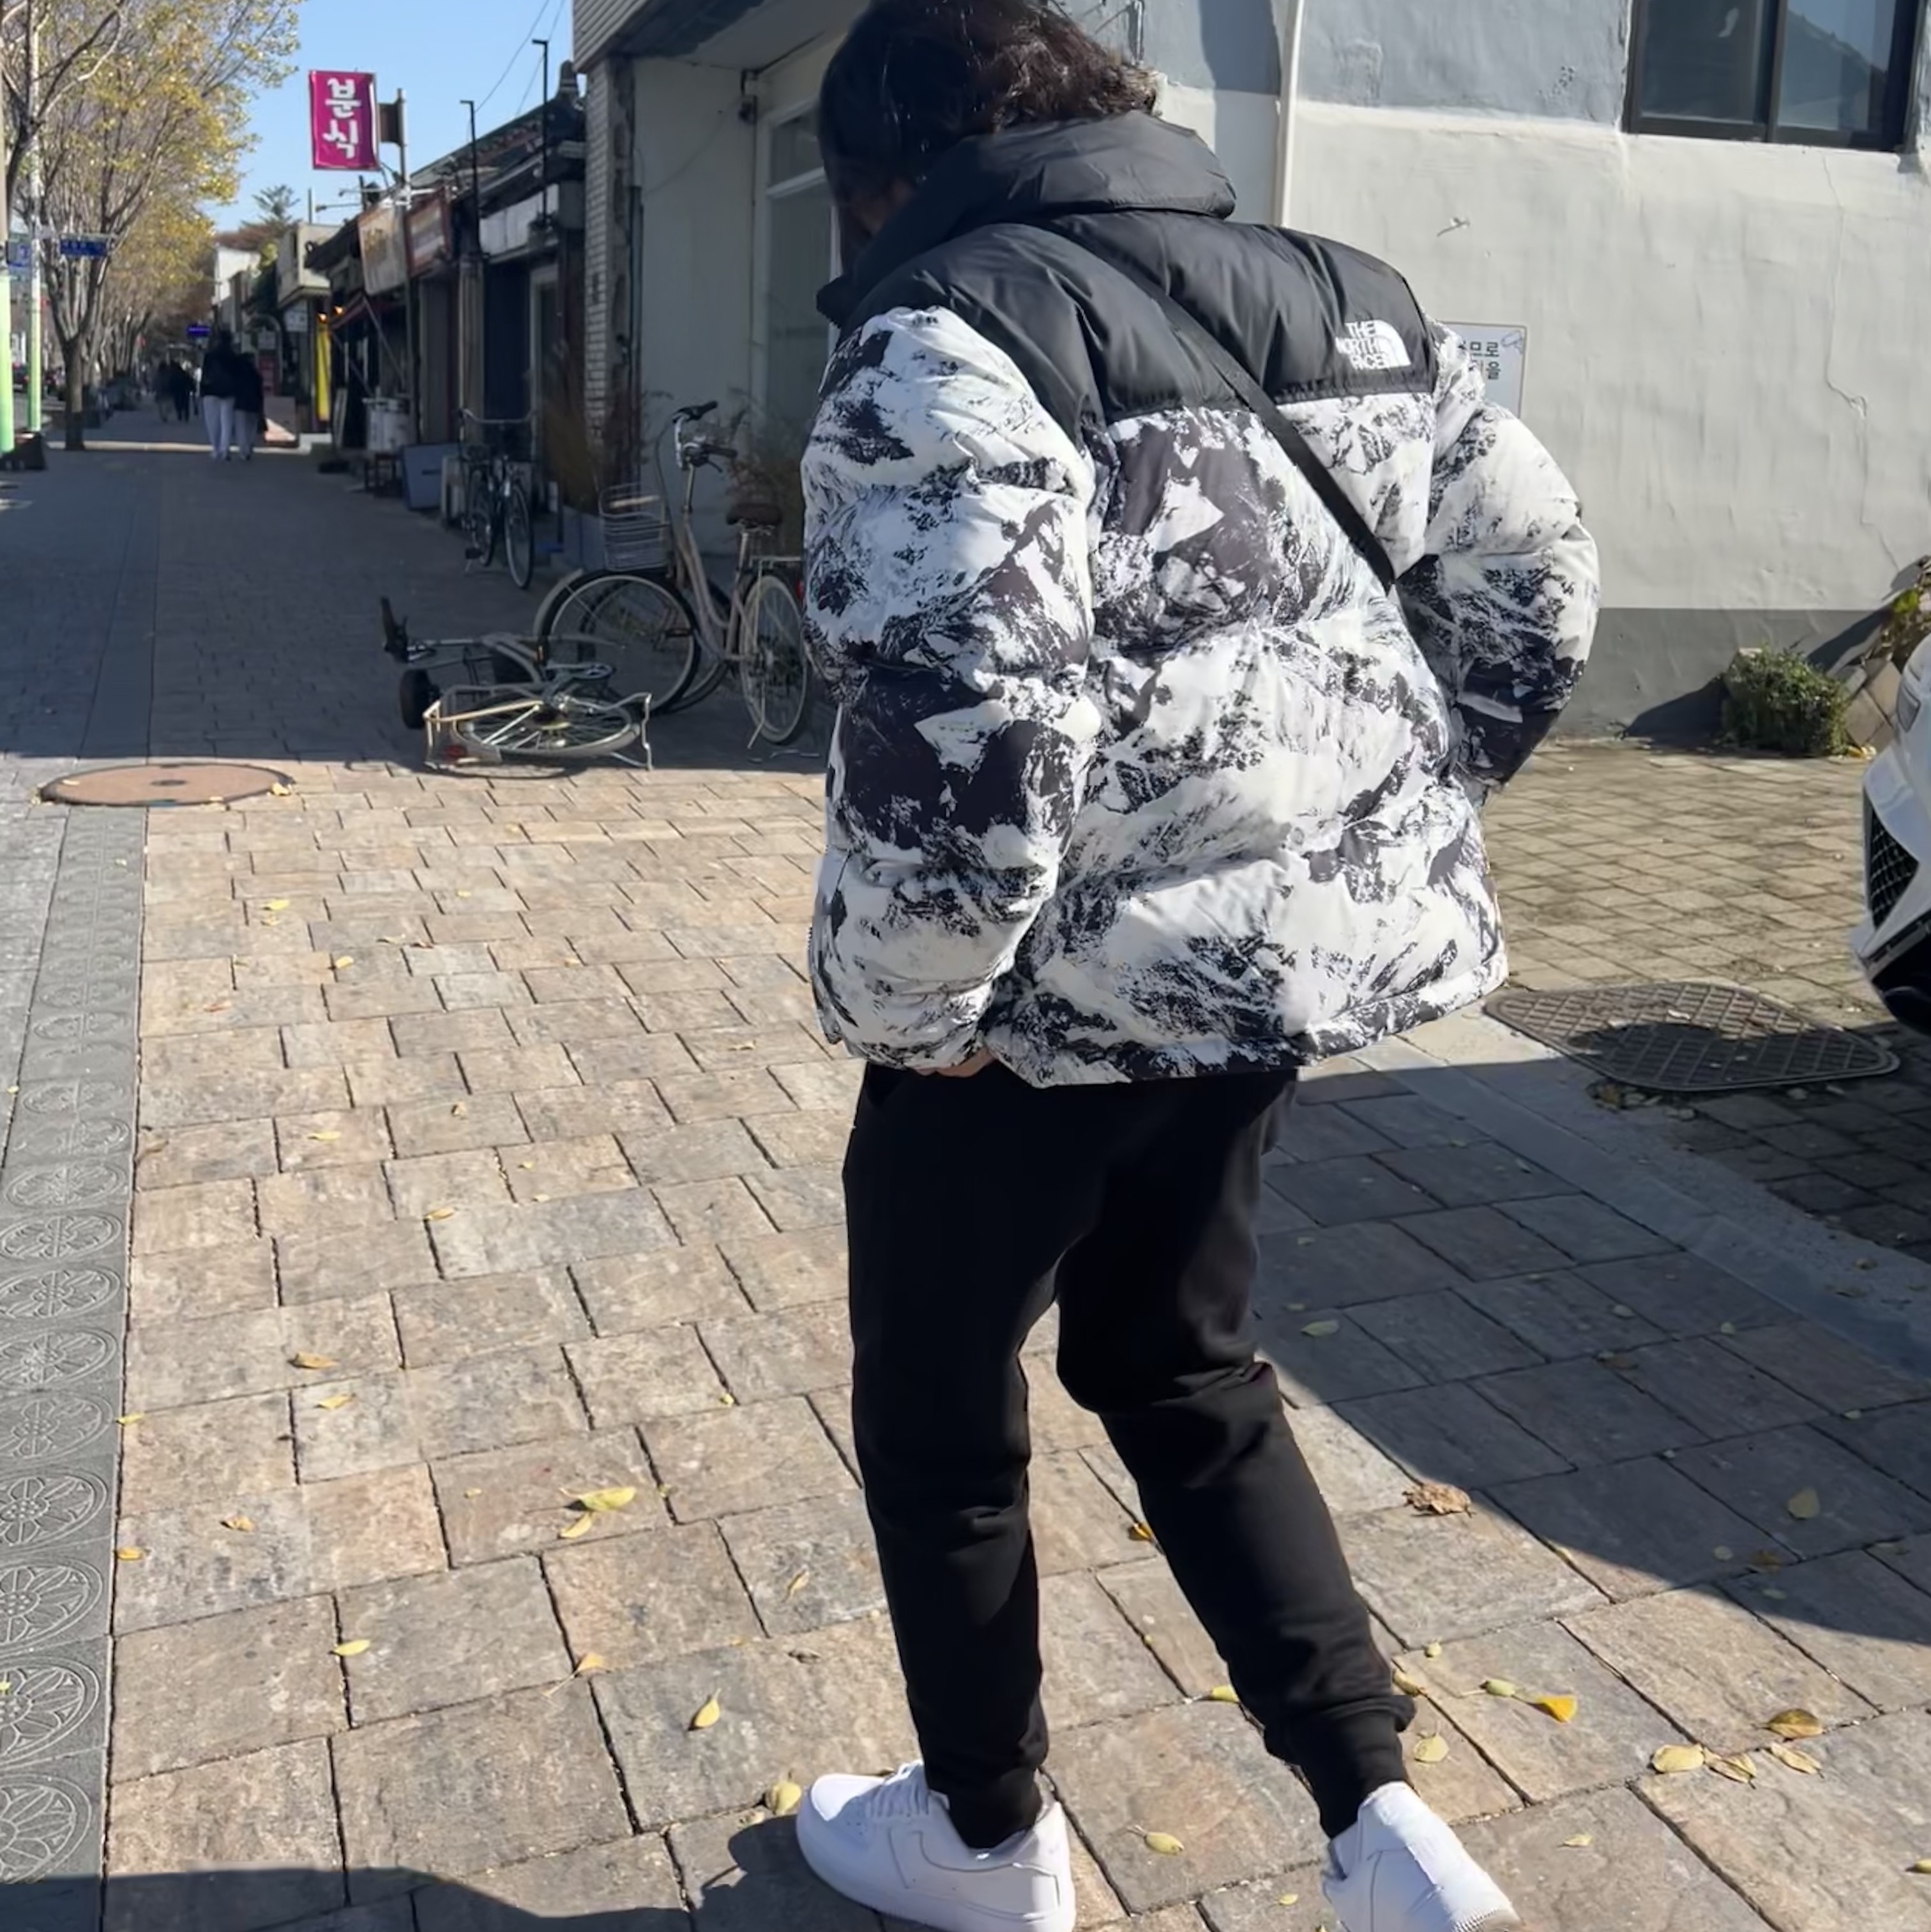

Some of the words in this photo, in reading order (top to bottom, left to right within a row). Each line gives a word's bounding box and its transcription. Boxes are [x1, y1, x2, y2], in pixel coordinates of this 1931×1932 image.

[322, 77, 361, 158] 분식
[1344, 321, 1375, 338] THE
[1463, 341, 1499, 358] 므로
[1349, 353, 1390, 370] FACE
